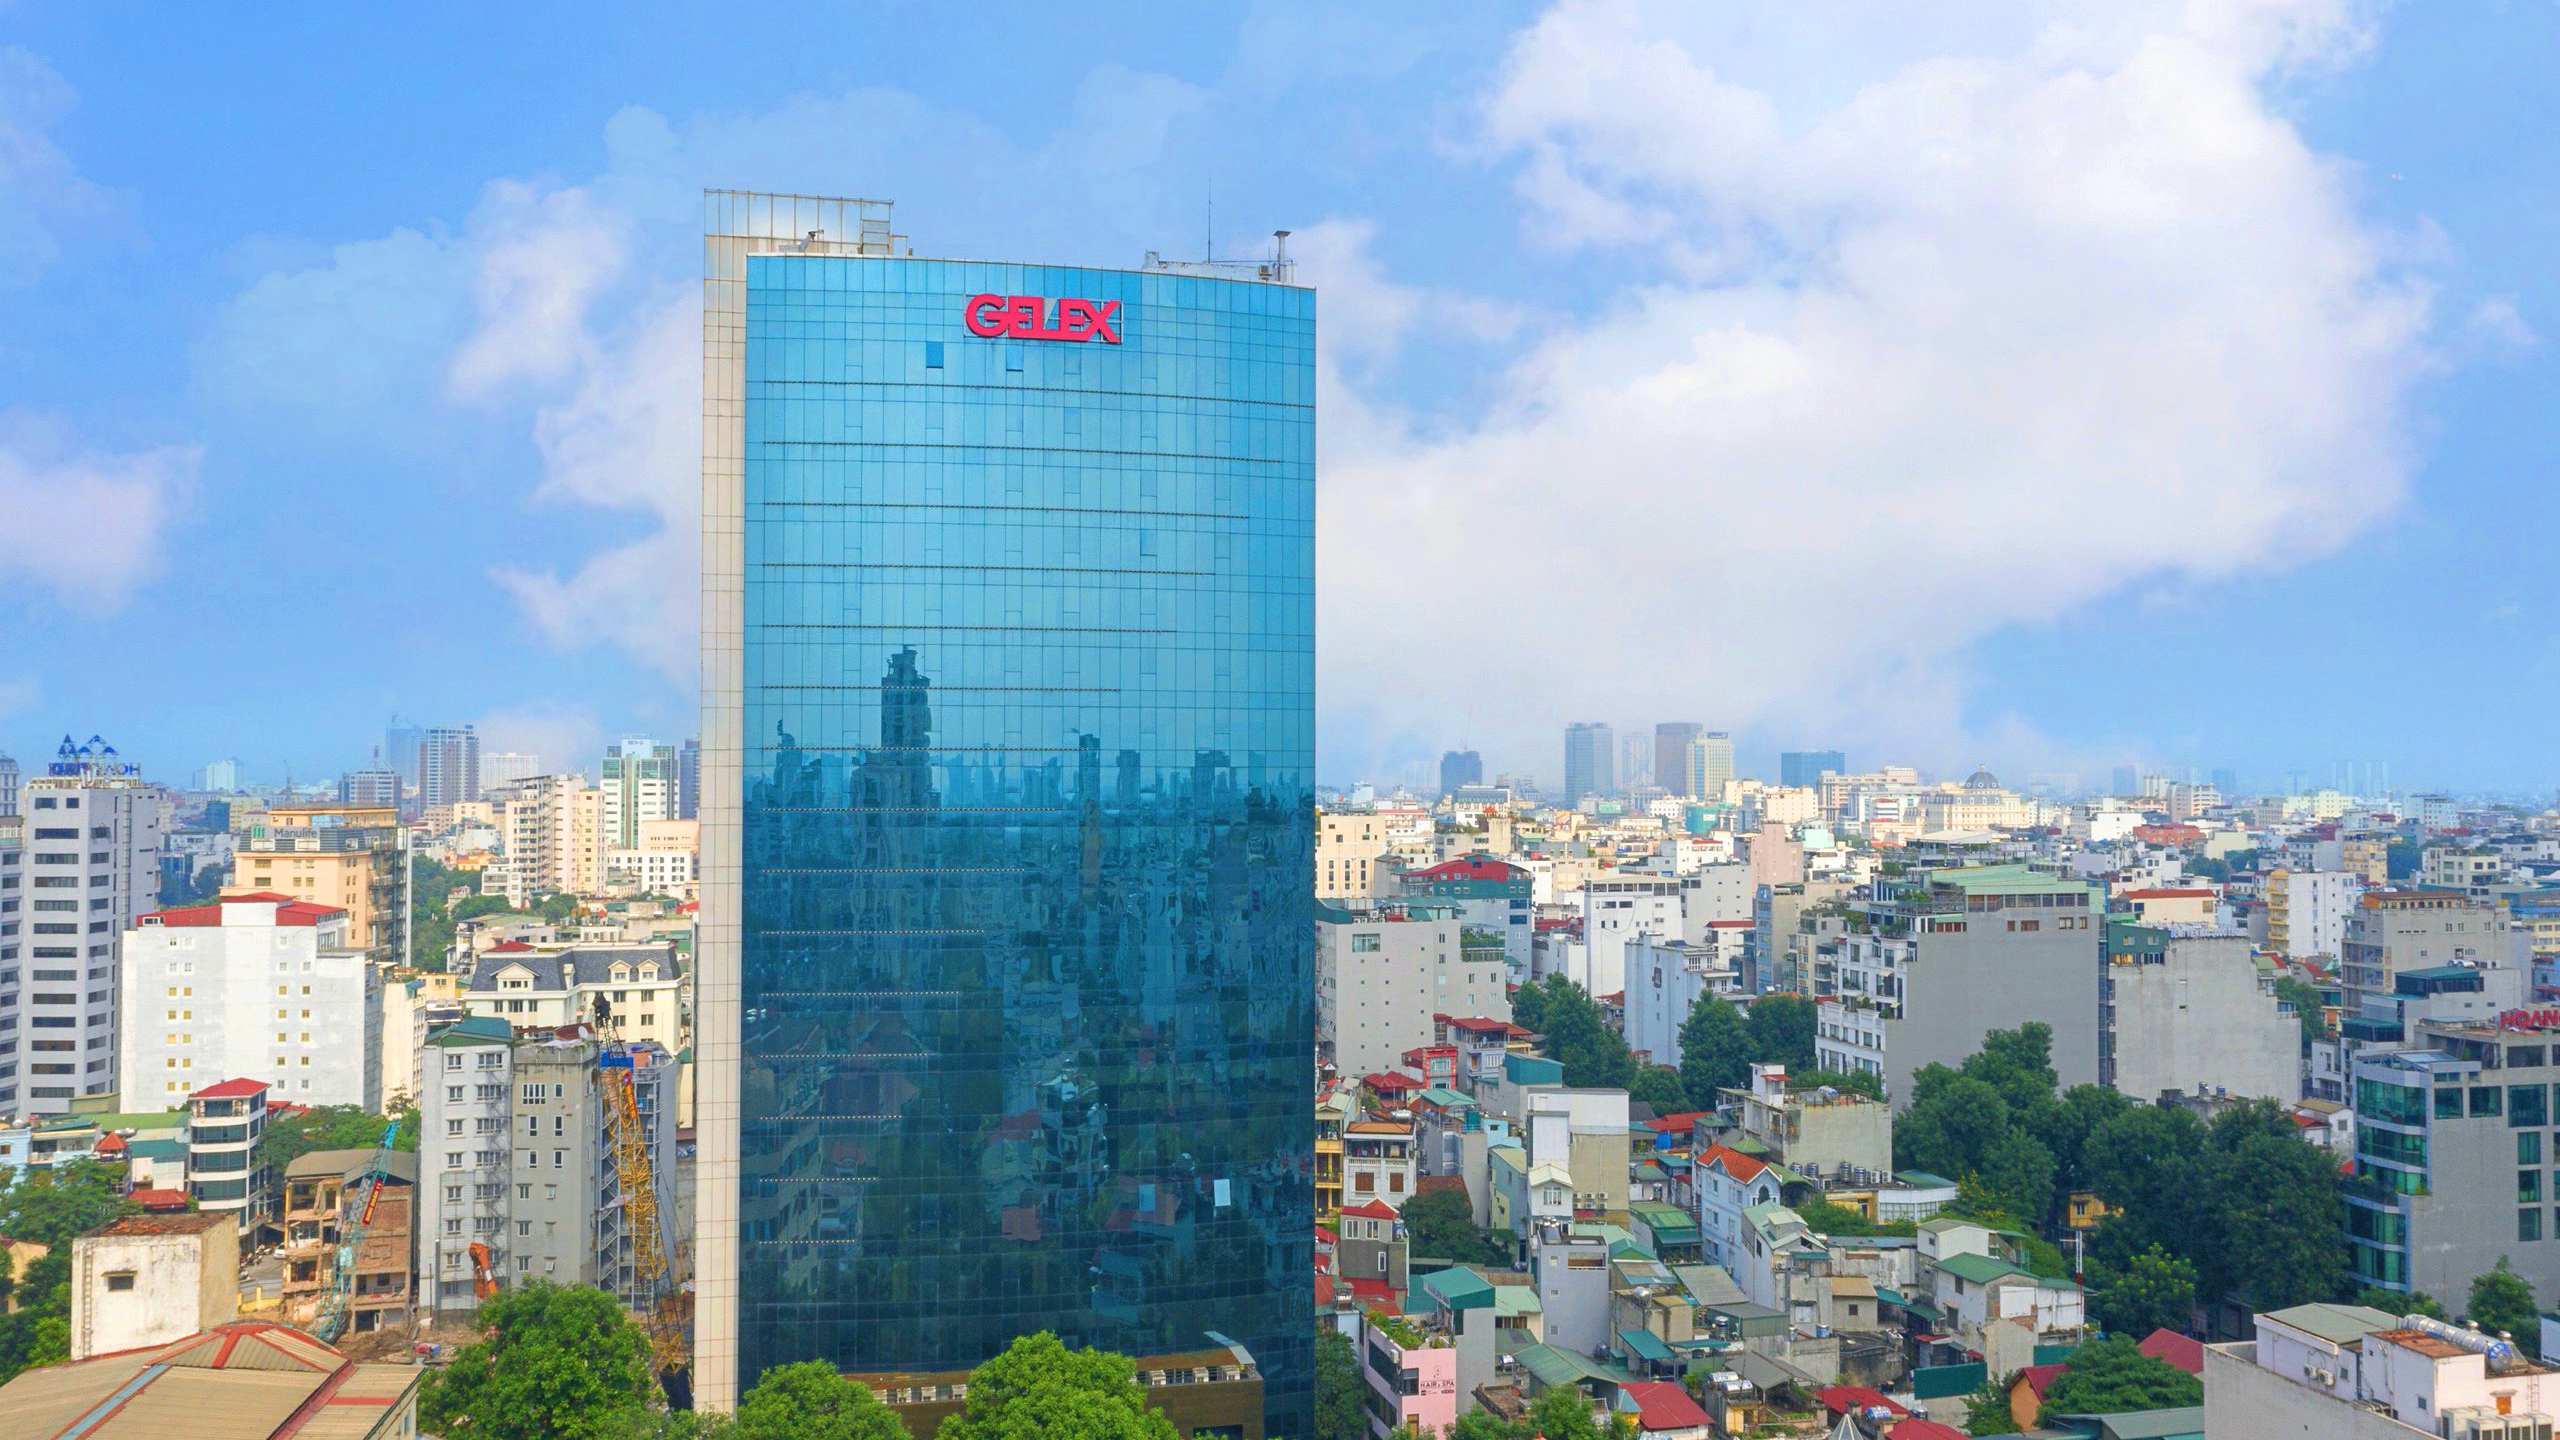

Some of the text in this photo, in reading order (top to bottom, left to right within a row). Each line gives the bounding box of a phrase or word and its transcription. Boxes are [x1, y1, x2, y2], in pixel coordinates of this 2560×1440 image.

[964, 293, 1121, 344] GELEX
[274, 826, 318, 838] Manulife
[2499, 1009, 2560, 1028] HOAN
